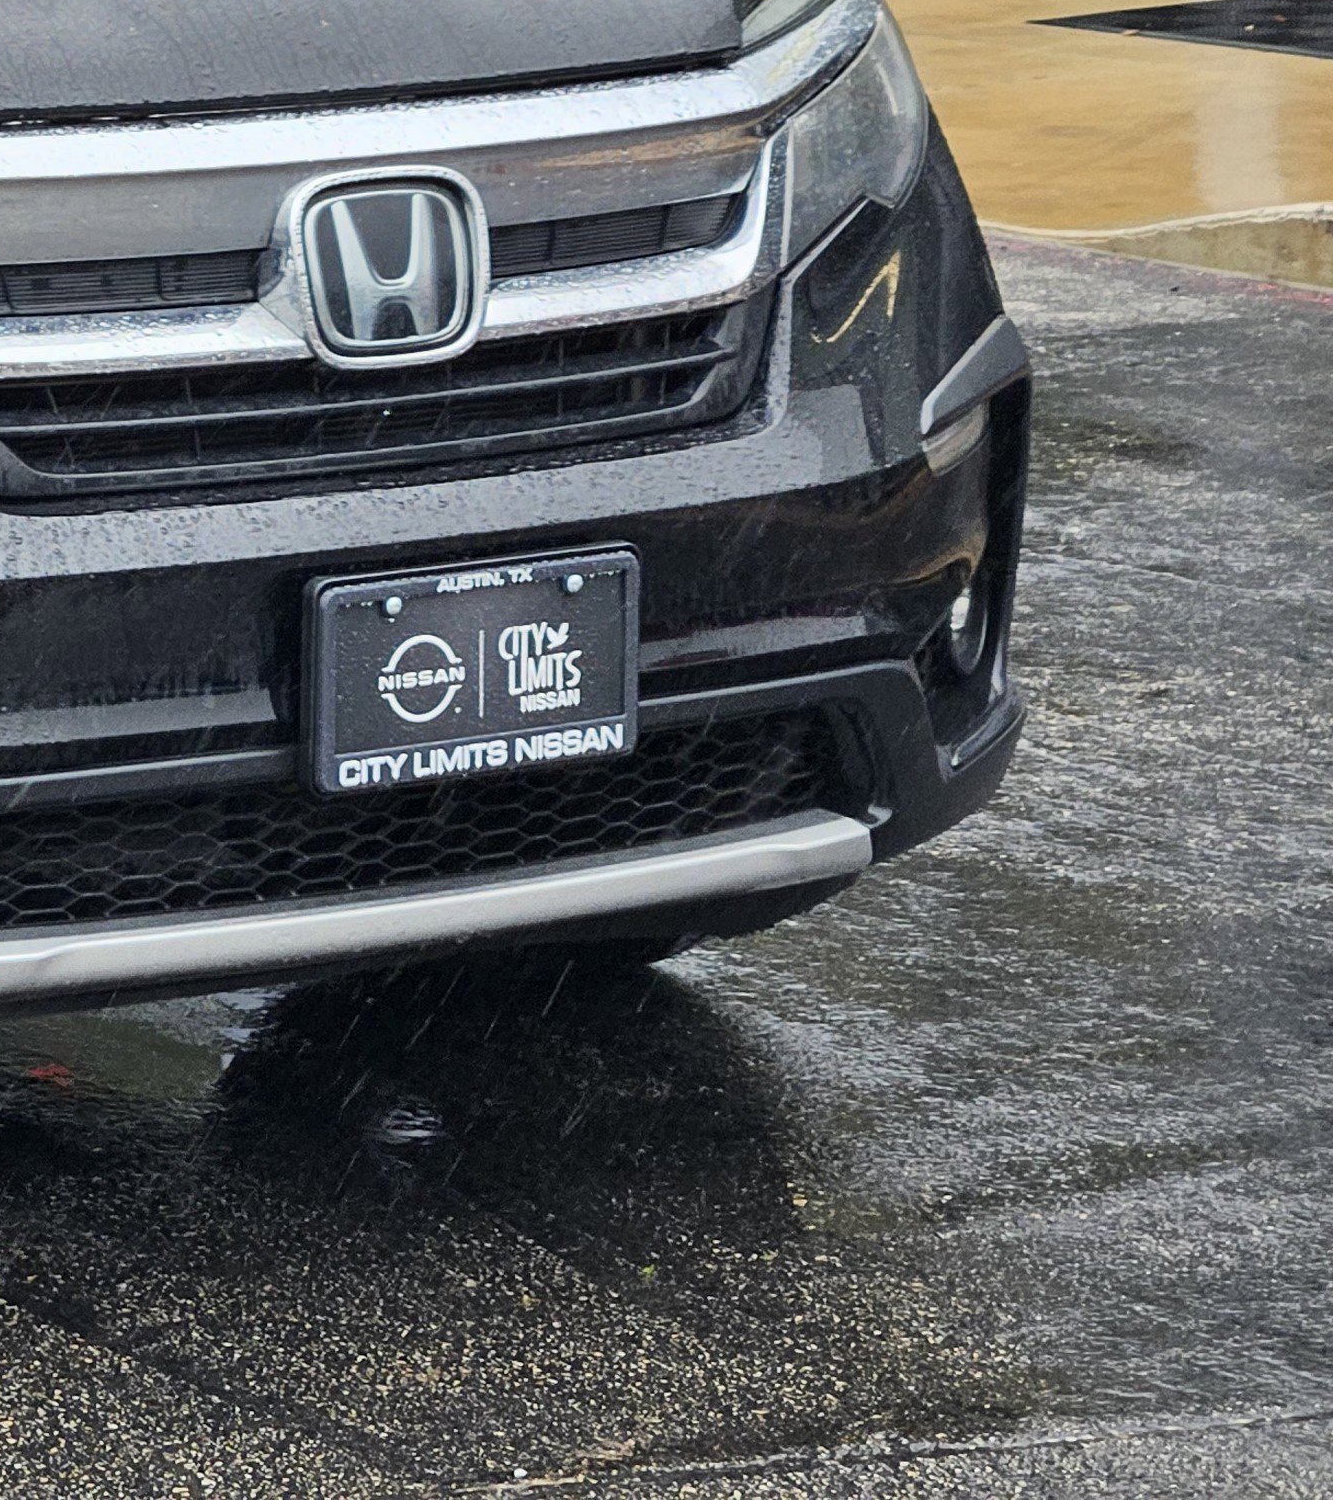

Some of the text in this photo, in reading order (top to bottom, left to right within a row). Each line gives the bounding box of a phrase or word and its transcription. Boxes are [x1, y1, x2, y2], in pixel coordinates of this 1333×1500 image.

[507, 567, 533, 583] TX
[498, 622, 549, 661] CITY
[378, 666, 465, 692] NISSAN
[508, 650, 582, 696] LIMITS
[520, 689, 581, 714] NISSAN
[339, 723, 624, 788] CITY LIMITS NISSAN
